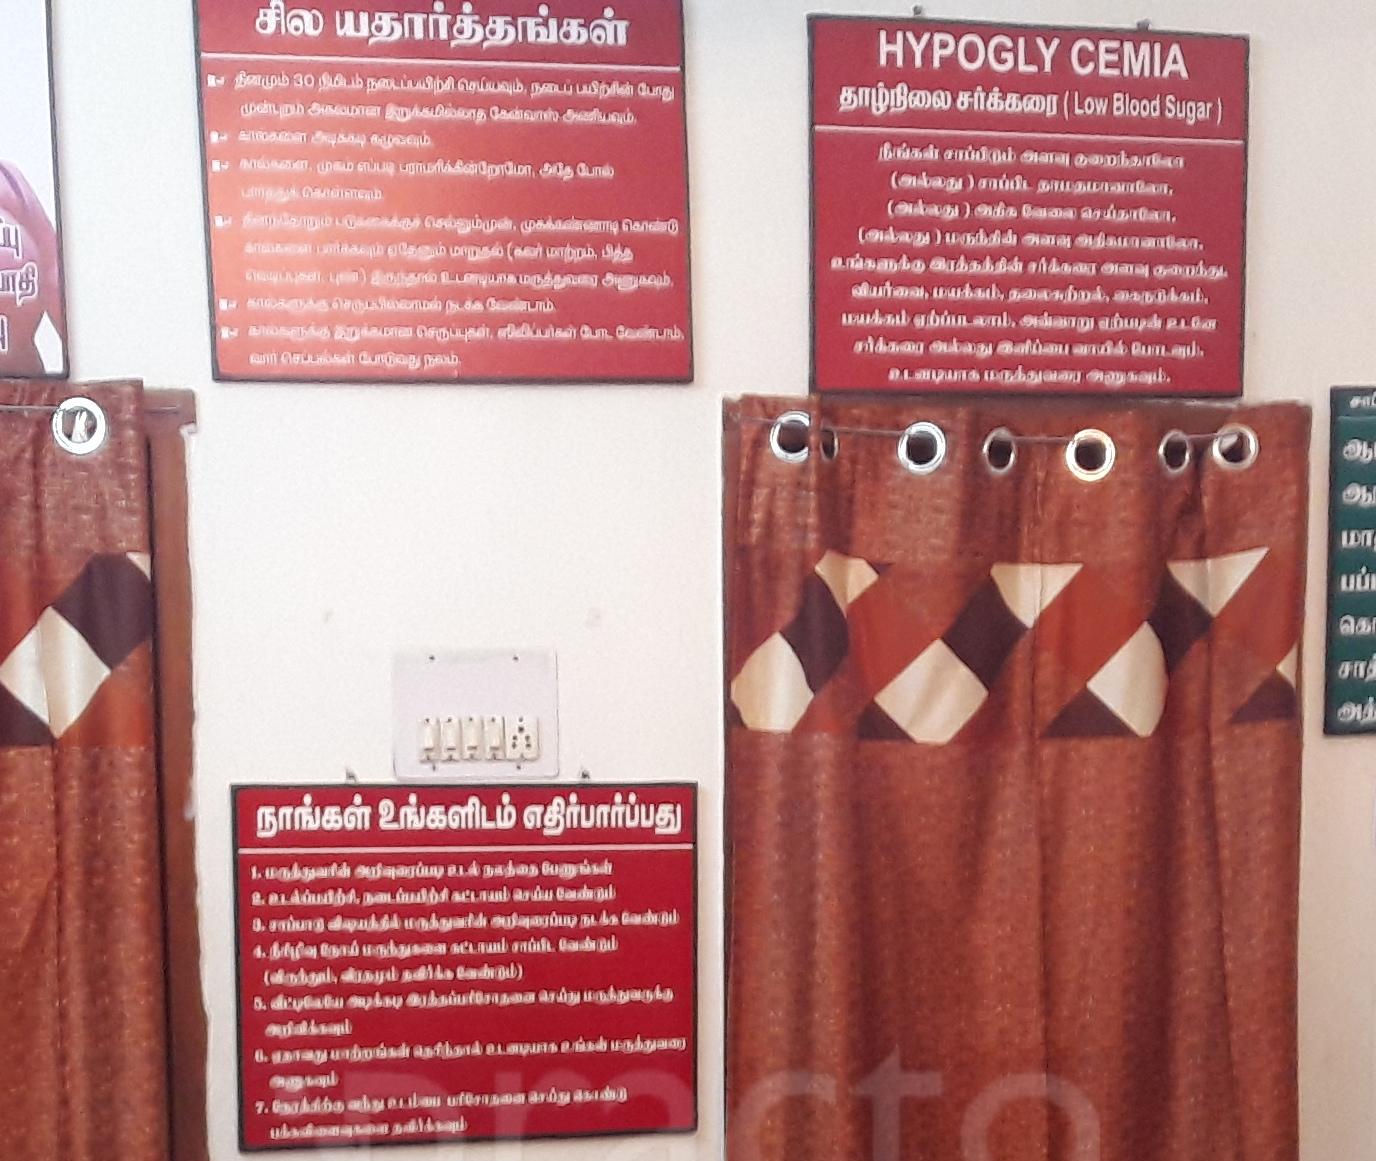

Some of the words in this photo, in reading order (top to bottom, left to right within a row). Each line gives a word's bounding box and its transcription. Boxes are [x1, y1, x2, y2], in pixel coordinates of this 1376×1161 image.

[254, 0, 324, 38] சில
[335, 1, 630, 48] யதார்த்தங்கள்
[878, 30, 1061, 74] HYPOGLY
[1070, 37, 1189, 80] CEMIA
[293, 74, 315, 88] 30
[839, 81, 952, 116] தாழ்நிலை
[956, 86, 1058, 118] சர்க்கரை
[1074, 92, 1108, 115] Low
[1112, 94, 1160, 118] Blood
[1165, 95, 1213, 125] Sugar
[256, 793, 371, 838] நாங்கள்
[378, 792, 517, 830] உங்களிடம்
[523, 791, 682, 837] எதிர்பார்ப்பது
